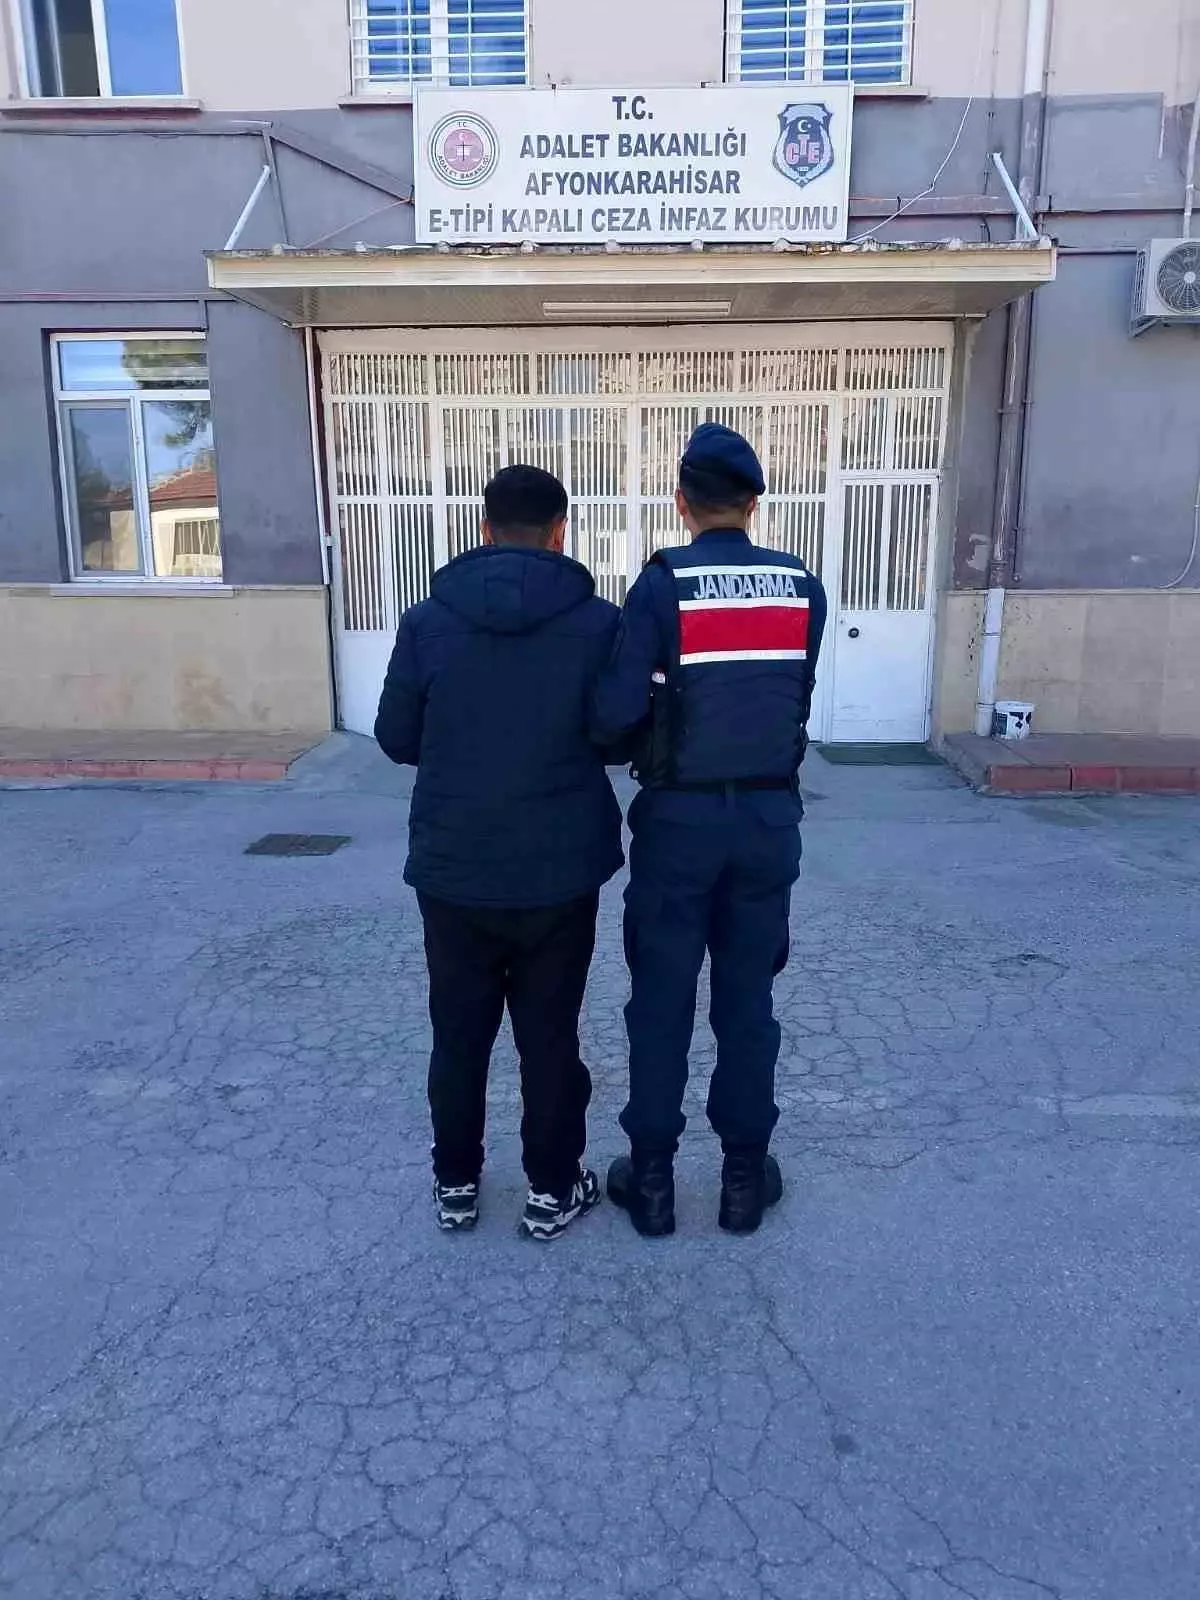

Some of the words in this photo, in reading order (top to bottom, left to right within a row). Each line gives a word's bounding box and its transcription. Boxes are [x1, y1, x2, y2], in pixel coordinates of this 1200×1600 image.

[612, 96, 654, 120] T.C.
[520, 134, 610, 159] ADALET
[618, 126, 747, 158] BAKANLIĞI
[525, 164, 741, 196] AFYONKARAHİSAR
[429, 202, 493, 233] E-TİPİ
[502, 208, 583, 232] KAPALI
[591, 207, 652, 232] CEZA
[660, 201, 727, 231] İNFAZ
[735, 206, 838, 231] KURUMU
[693, 574, 798, 599] JANDARMA
